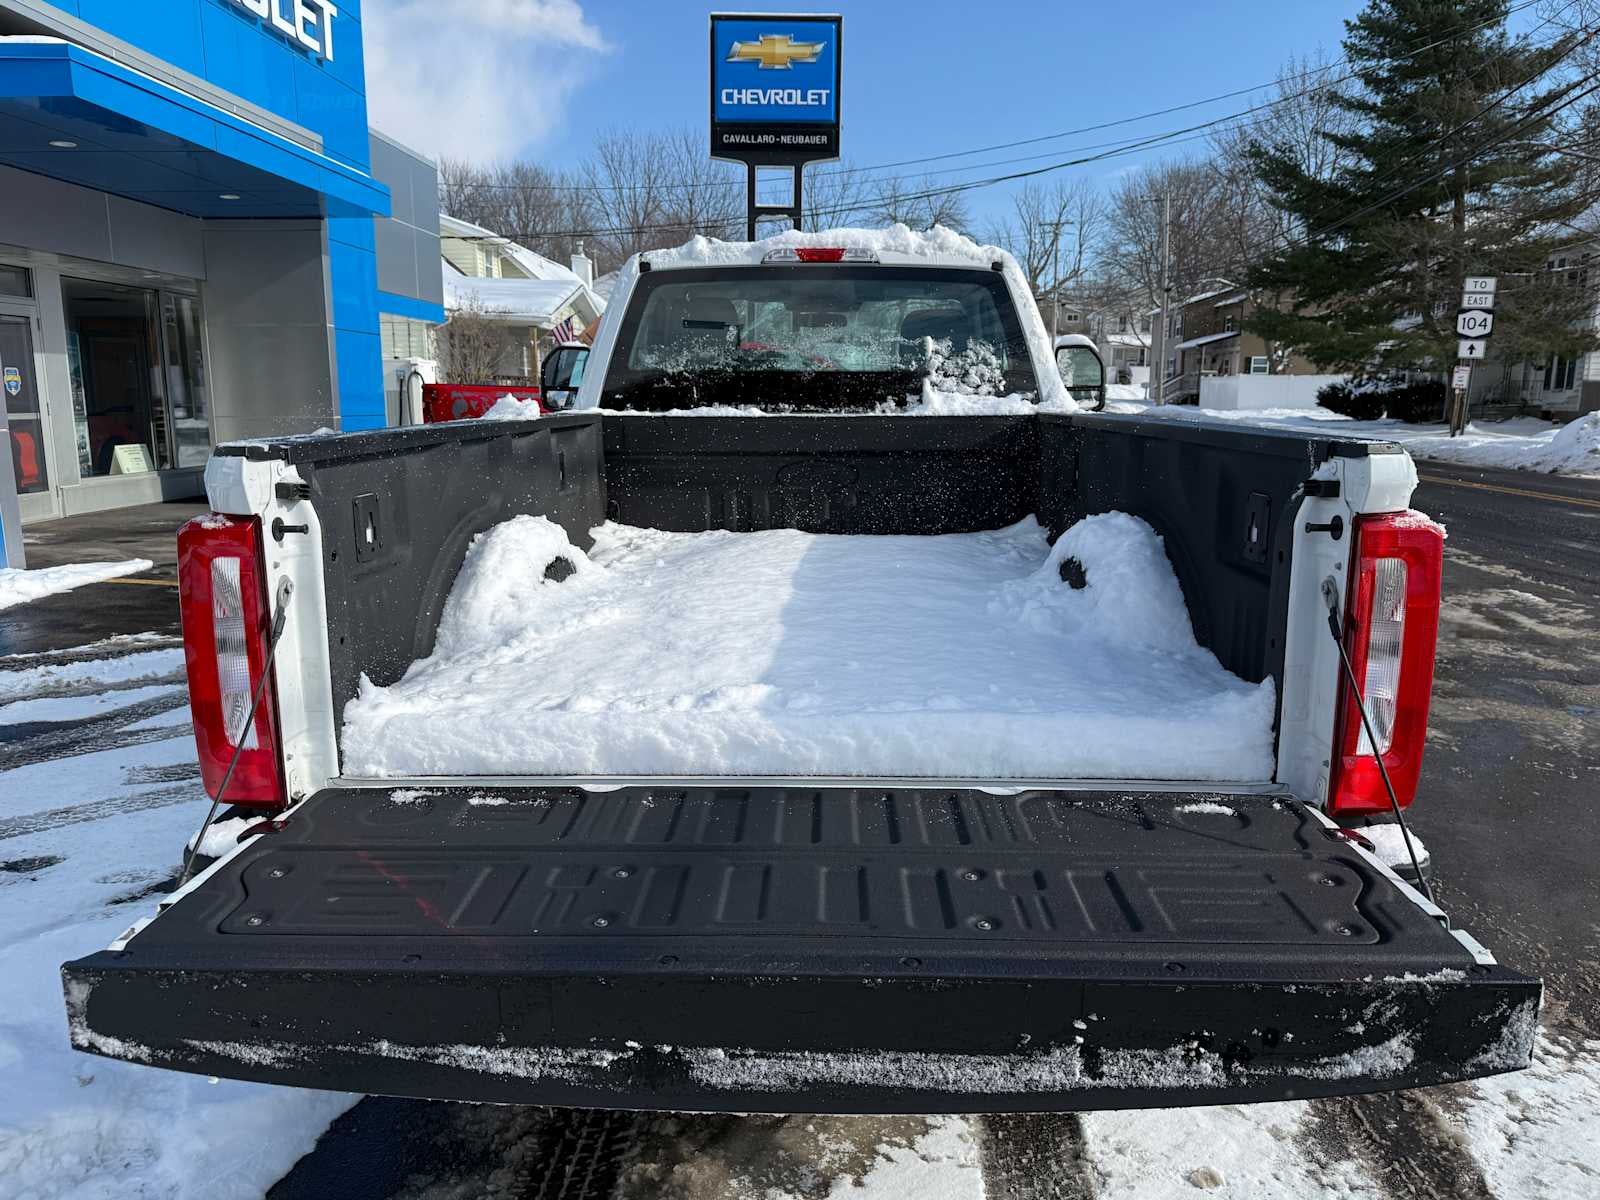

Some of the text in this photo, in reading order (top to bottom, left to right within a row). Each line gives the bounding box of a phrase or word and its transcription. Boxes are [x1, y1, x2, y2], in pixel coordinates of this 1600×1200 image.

[236, 0, 338, 62] LET
[721, 88, 830, 106] CHEVROLET
[722, 133, 828, 145] CAVALLARO-NEUBAUER
[1472, 280, 1488, 289] TO
[1466, 295, 1489, 306] EAST
[1461, 316, 1489, 331] 104
